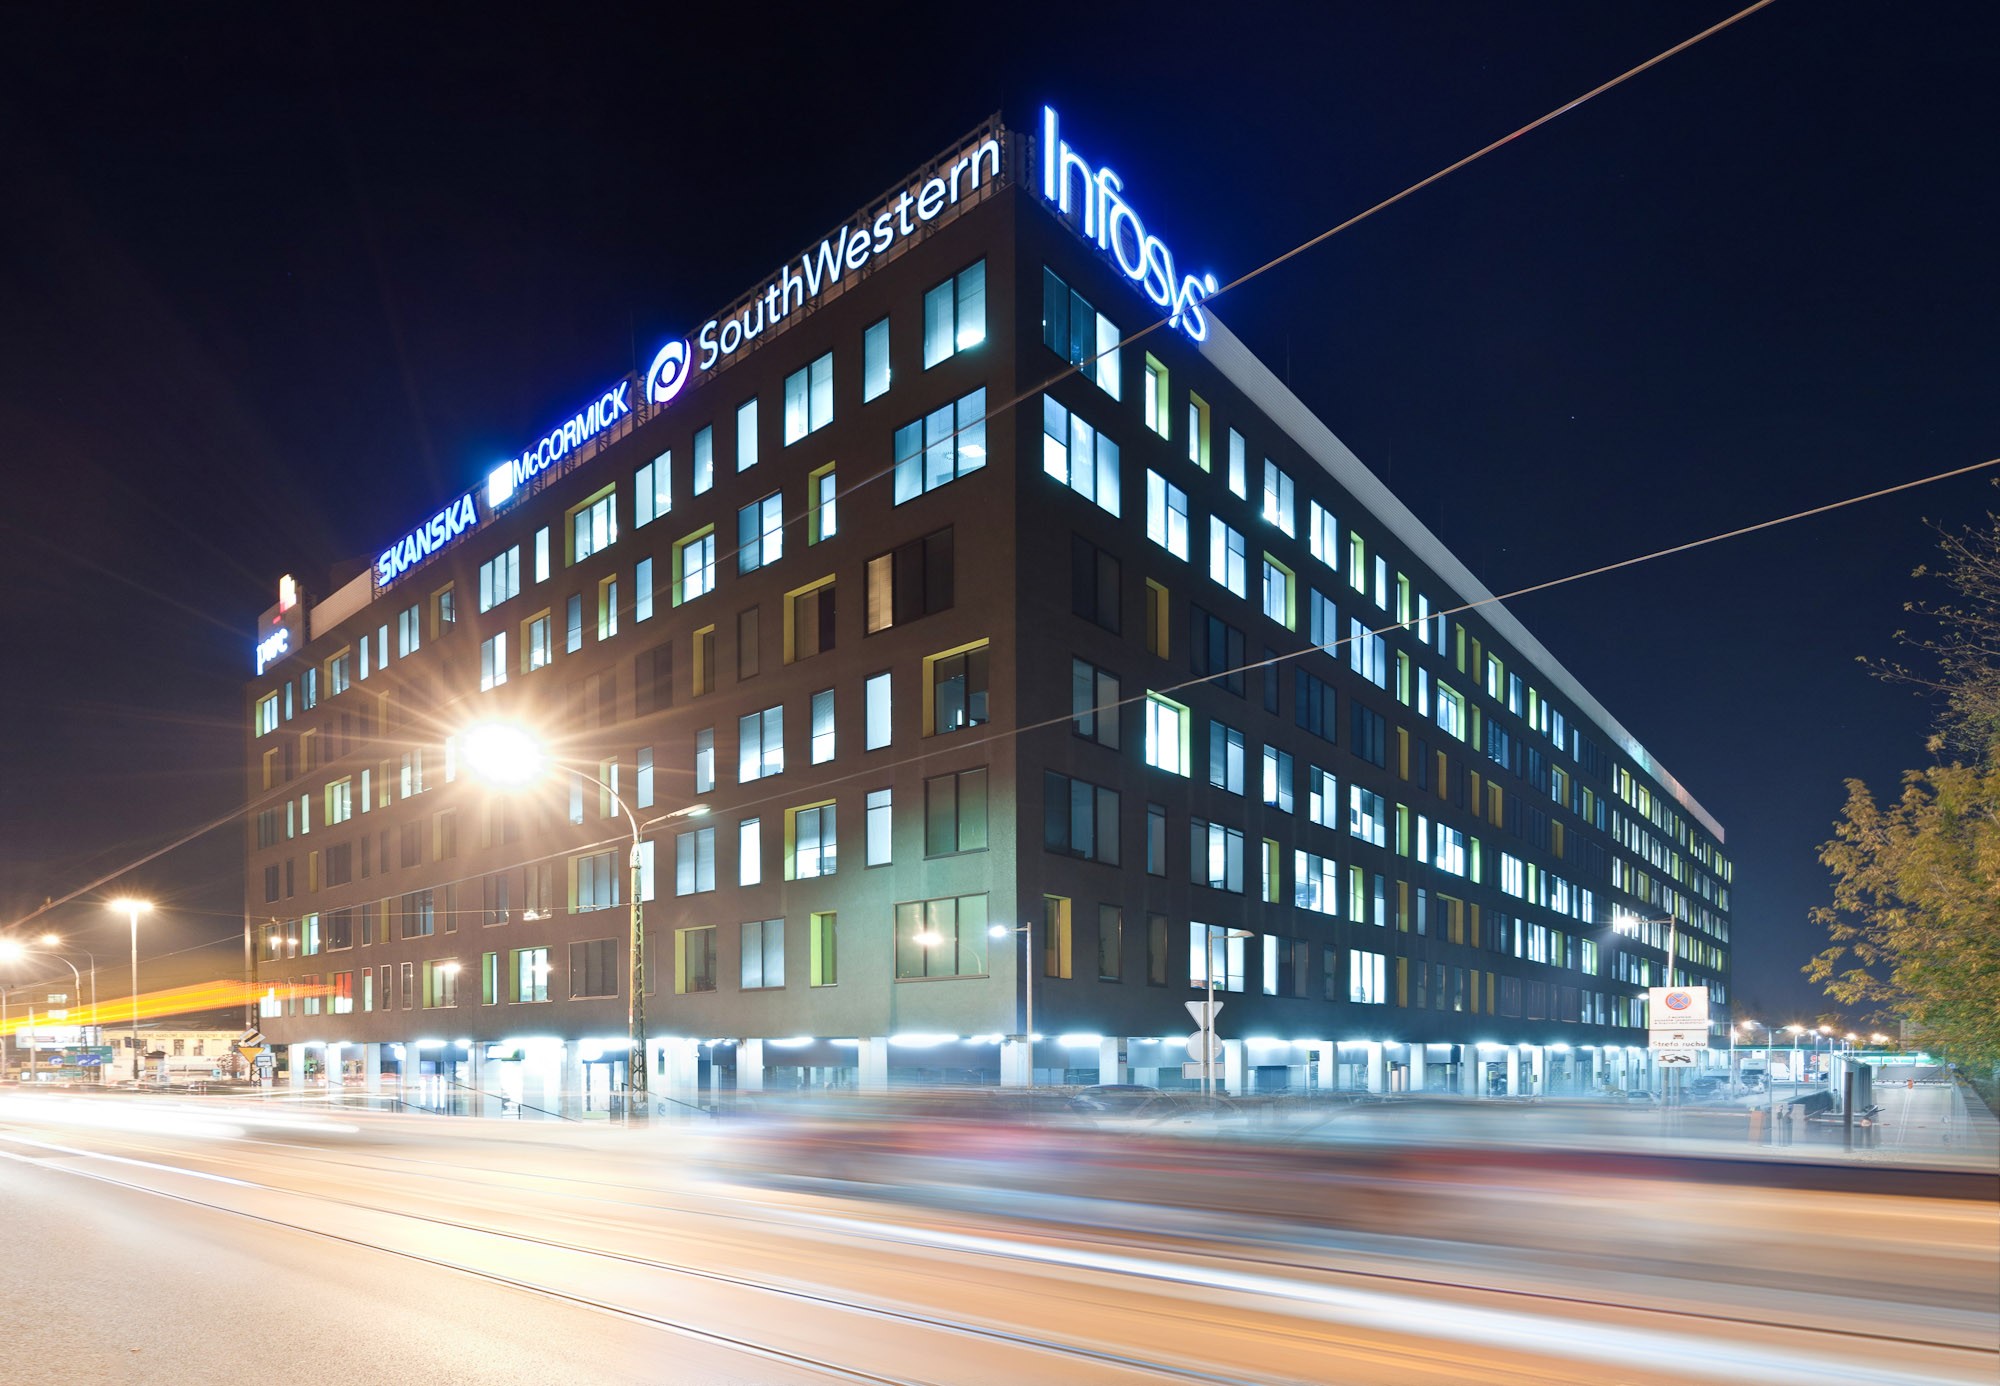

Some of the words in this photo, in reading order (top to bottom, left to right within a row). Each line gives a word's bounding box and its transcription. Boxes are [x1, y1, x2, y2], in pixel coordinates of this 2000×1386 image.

[699, 138, 1000, 371] SouthWestern
[1044, 105, 1212, 342] Infosys
[513, 380, 629, 488] McCORMICK
[378, 493, 477, 587] SKANSKA
[1652, 1040, 1679, 1048] Strefa
[1682, 1040, 1706, 1048] ruchu
